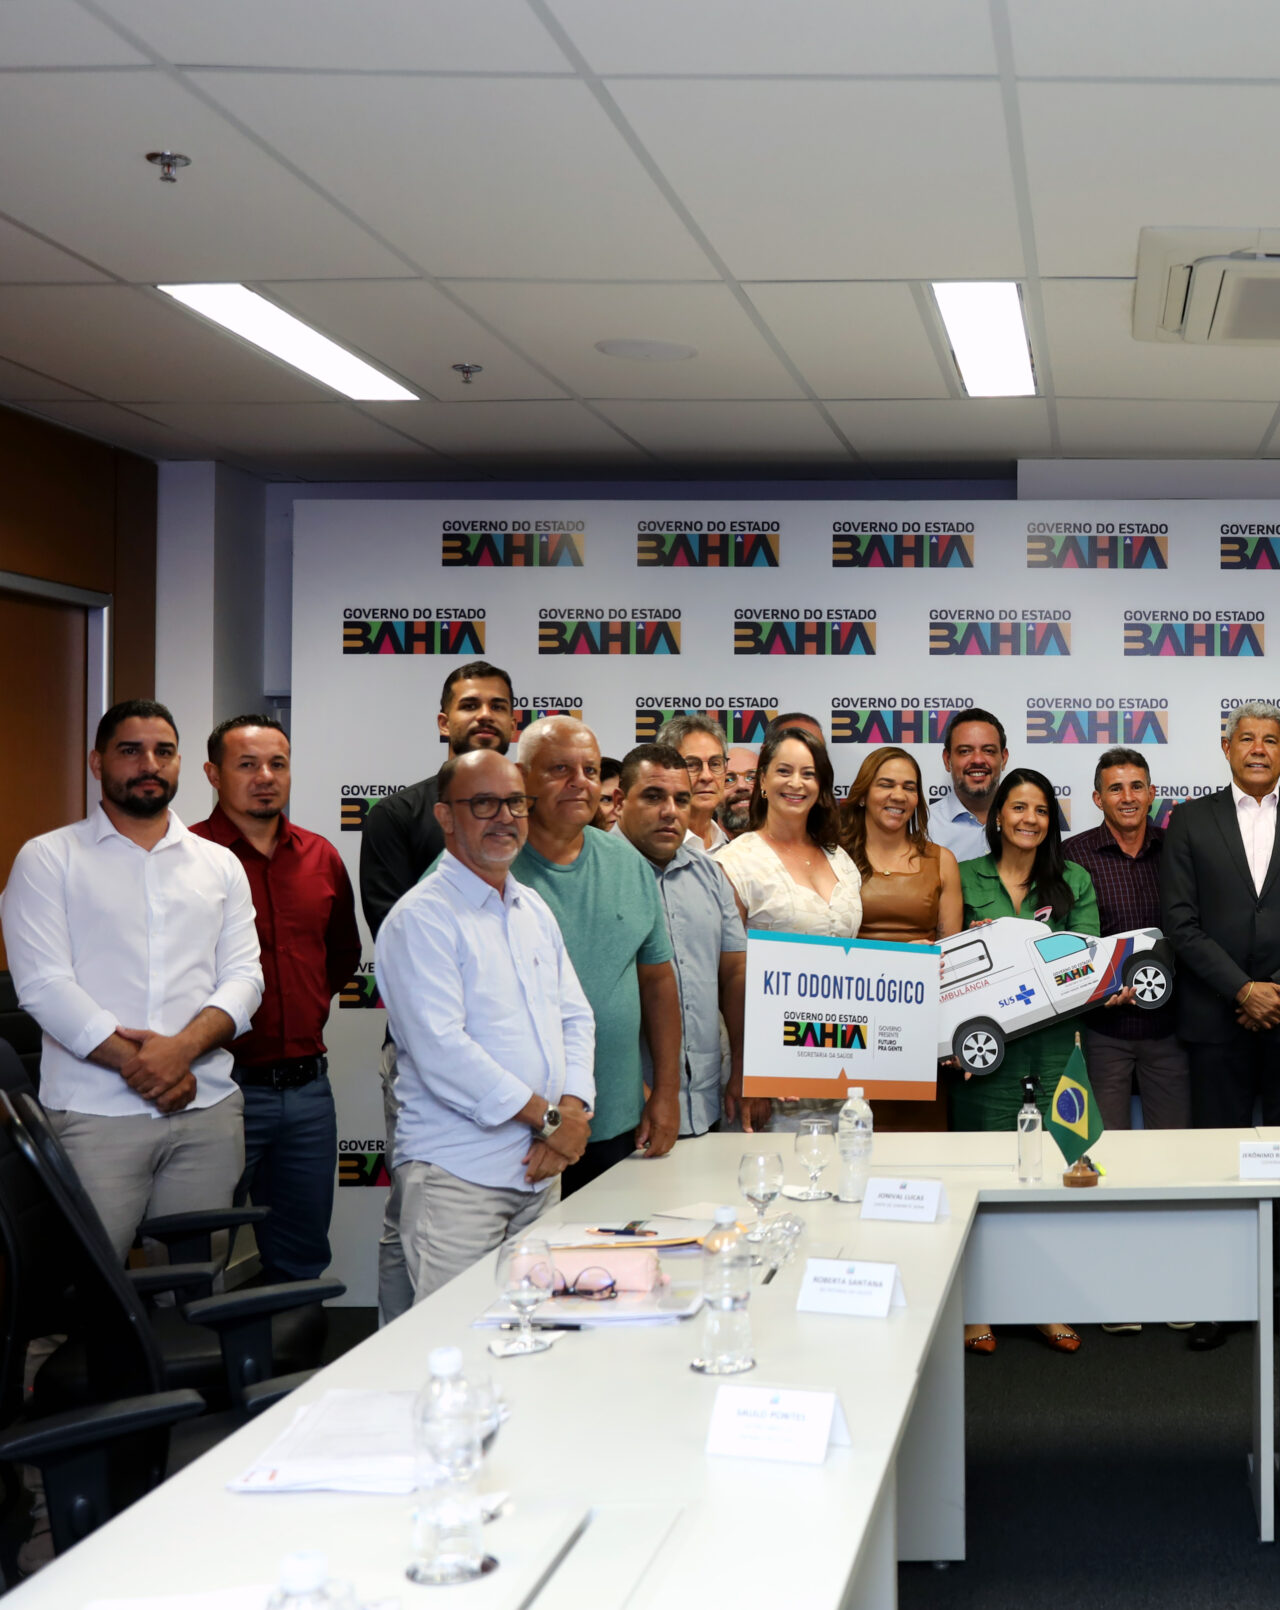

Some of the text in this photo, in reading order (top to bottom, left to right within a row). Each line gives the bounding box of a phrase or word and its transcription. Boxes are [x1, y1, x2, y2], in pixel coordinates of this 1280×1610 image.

[442, 520, 584, 532] GOVERNO DO ESTADO
[637, 520, 780, 532] GOVERNO DO ESTADO
[832, 522, 974, 534] GOVERNO DO ESTADO
[1026, 522, 1168, 534] GOVERNO DO ESTADO
[442, 534, 584, 567] BAHIA
[638, 534, 780, 567] BAHIA
[832, 535, 974, 568] BAHIA
[1027, 536, 1168, 569] BAHIA
[342, 608, 486, 620] GOVERNO DO ESTADO
[538, 608, 682, 620] GOVERNO DO ESTADO
[734, 608, 876, 620] GOVERNO DO ESTADO
[928, 610, 1072, 621] GOVERNO DO ESTADO
[1123, 610, 1265, 622] GOVERNO DO ESTADO
[343, 621, 486, 654] BAHIA
[539, 621, 681, 654] BAHIA
[734, 622, 876, 655] BAHIA
[929, 622, 1071, 655] BAHIA
[1124, 623, 1264, 656] BAHIA
[533, 697, 583, 708] ESTADO
[635, 697, 779, 708] GOVERNO DO ESTADO
[831, 697, 974, 708] GOVERNO DO ESTADO
[1026, 698, 1168, 710] GOVERNO DO ESTADO
[636, 710, 778, 743] BIA
[1027, 711, 1168, 744] BAHIA
[1154, 786, 1189, 796] ERNO
[1193, 786, 1212, 796] DO
[1054, 962, 1095, 986] BAHIA
[763, 970, 925, 1005] KIT ODONTOLÓGICO
[940, 979, 990, 1003] MBULÂNCIA
[998, 996, 1016, 1008] SUS
[784, 1011, 868, 1024] GOVERNO DO ESTADO
[784, 1021, 867, 1049] BAHIA
[338, 1140, 388, 1152] GOVER
